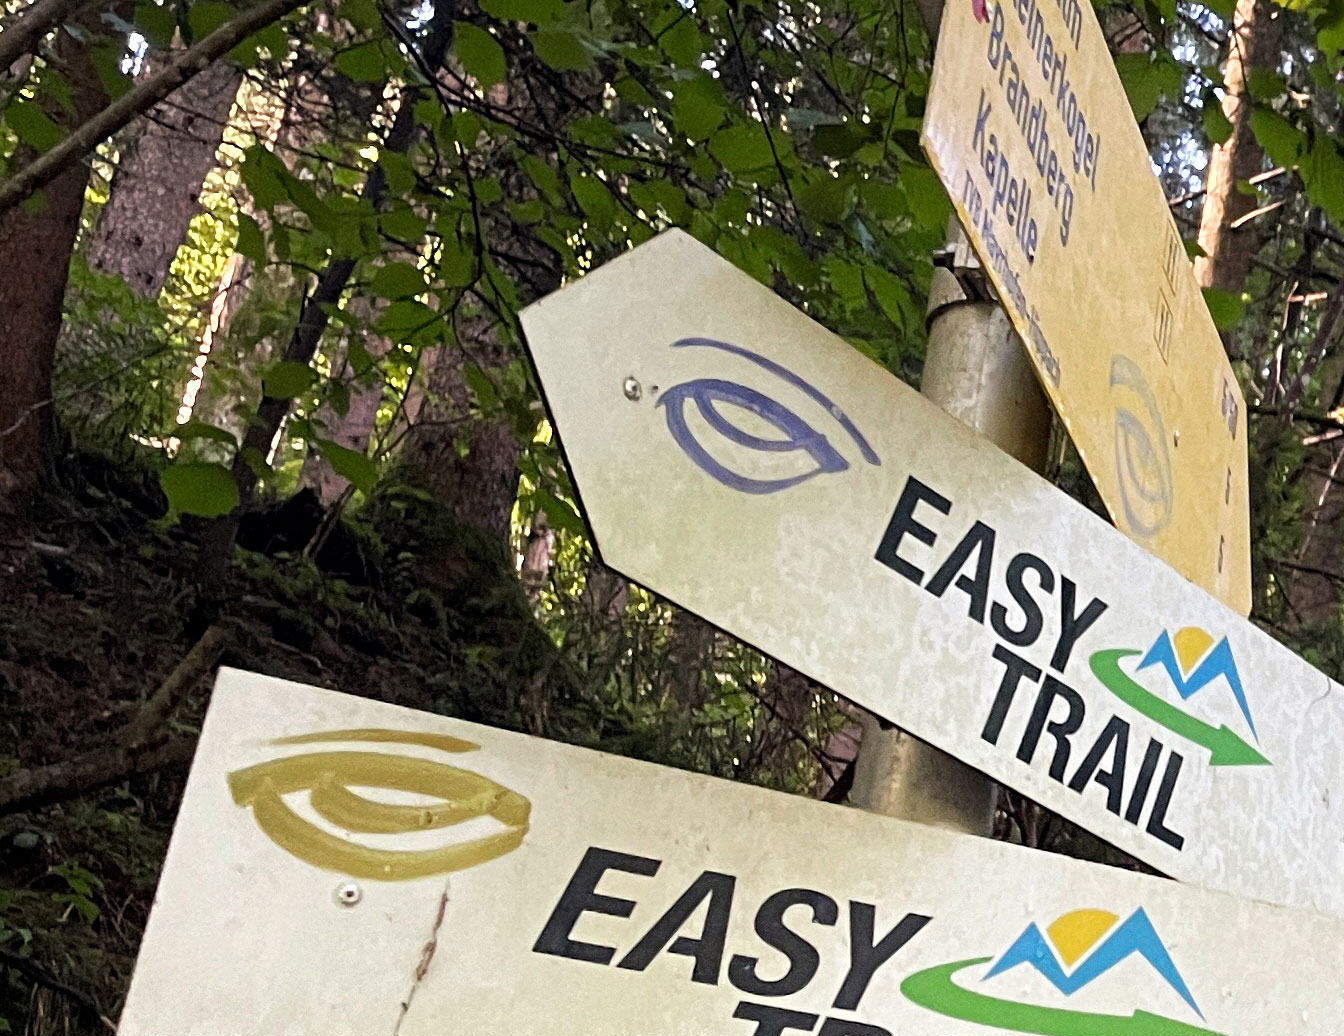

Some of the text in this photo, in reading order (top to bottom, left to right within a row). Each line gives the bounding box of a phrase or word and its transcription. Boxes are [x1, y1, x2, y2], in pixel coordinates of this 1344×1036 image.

[972, 87, 1038, 265] Kapelle
[987, 1, 1074, 247] Brandberg
[1012, 0, 1100, 190] einerkogel
[874, 476, 1108, 674] EASY
[981, 644, 1184, 852] TRAIL
[532, 847, 932, 1010] EASY
